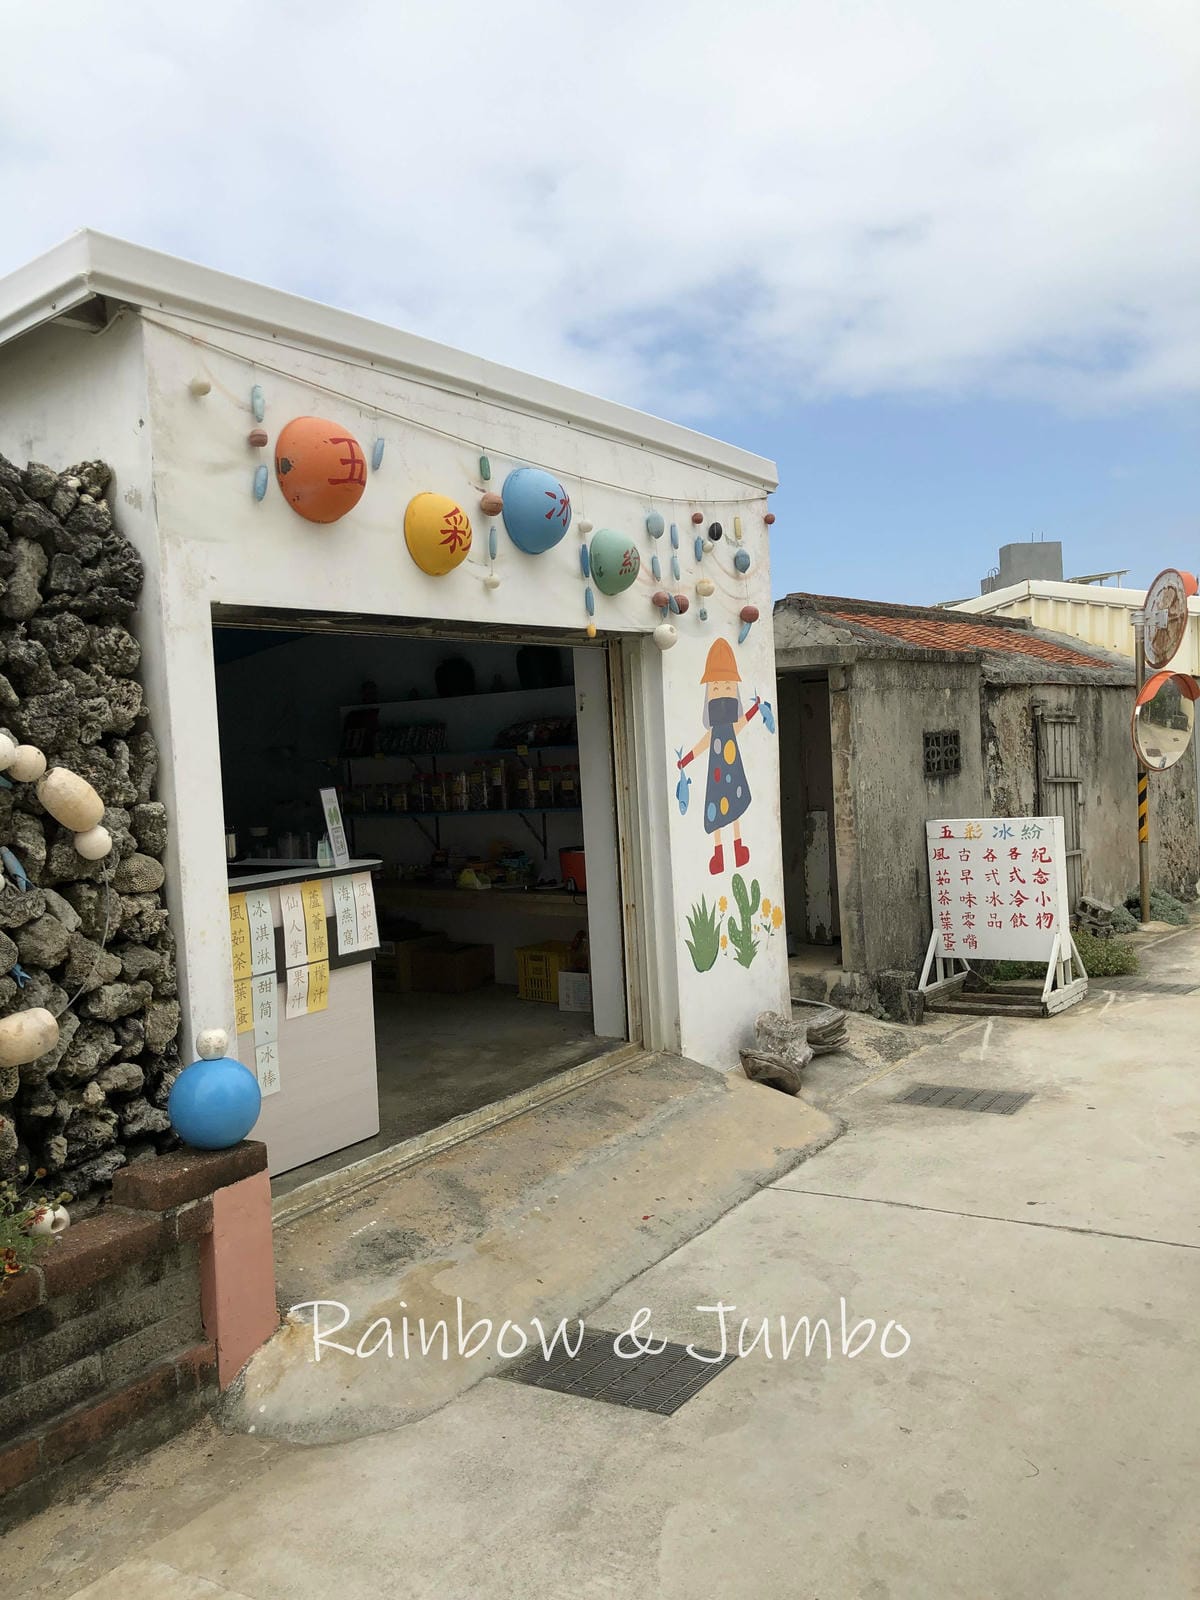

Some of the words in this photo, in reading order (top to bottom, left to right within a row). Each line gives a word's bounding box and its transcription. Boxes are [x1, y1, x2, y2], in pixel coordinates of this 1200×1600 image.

[939, 822, 1044, 840] 五彩冰紛
[958, 847, 978, 950] 古早味零嘴
[1007, 846, 1030, 929] 各式冷飲
[1031, 846, 1054, 930] 紀念小物
